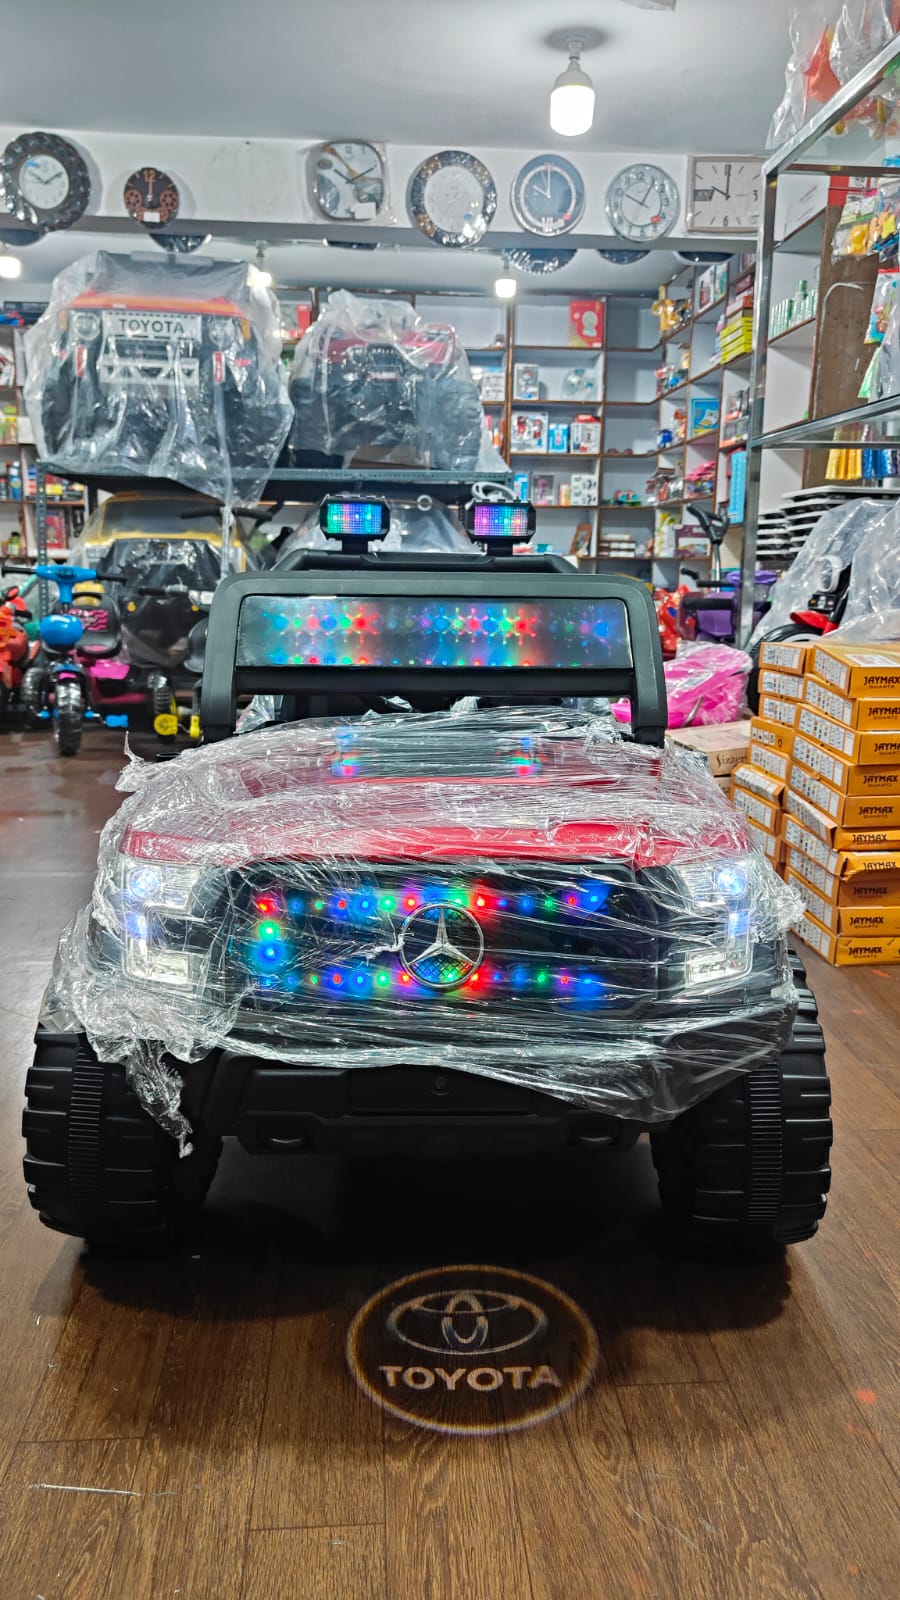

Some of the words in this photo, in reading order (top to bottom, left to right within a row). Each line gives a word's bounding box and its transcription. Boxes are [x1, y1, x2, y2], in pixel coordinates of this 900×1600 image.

[143, 169, 156, 182] 12
[753, 189, 758, 202] 3
[722, 215, 729, 227] 6
[118, 319, 185, 333] TOYOTA
[864, 676, 900, 686] JAYMAX
[863, 775, 899, 785] JAYMAX
[859, 806, 894, 815] JAYMAX
[852, 834, 888, 843] JAYMAX
[863, 862, 898, 870] JAYMAX
[853, 887, 888, 895] JAYMAX
[850, 917, 884, 926] JAYMAX
[848, 946, 883, 956] JAYMAX
[379, 1365, 562, 1391] TOYOTA
